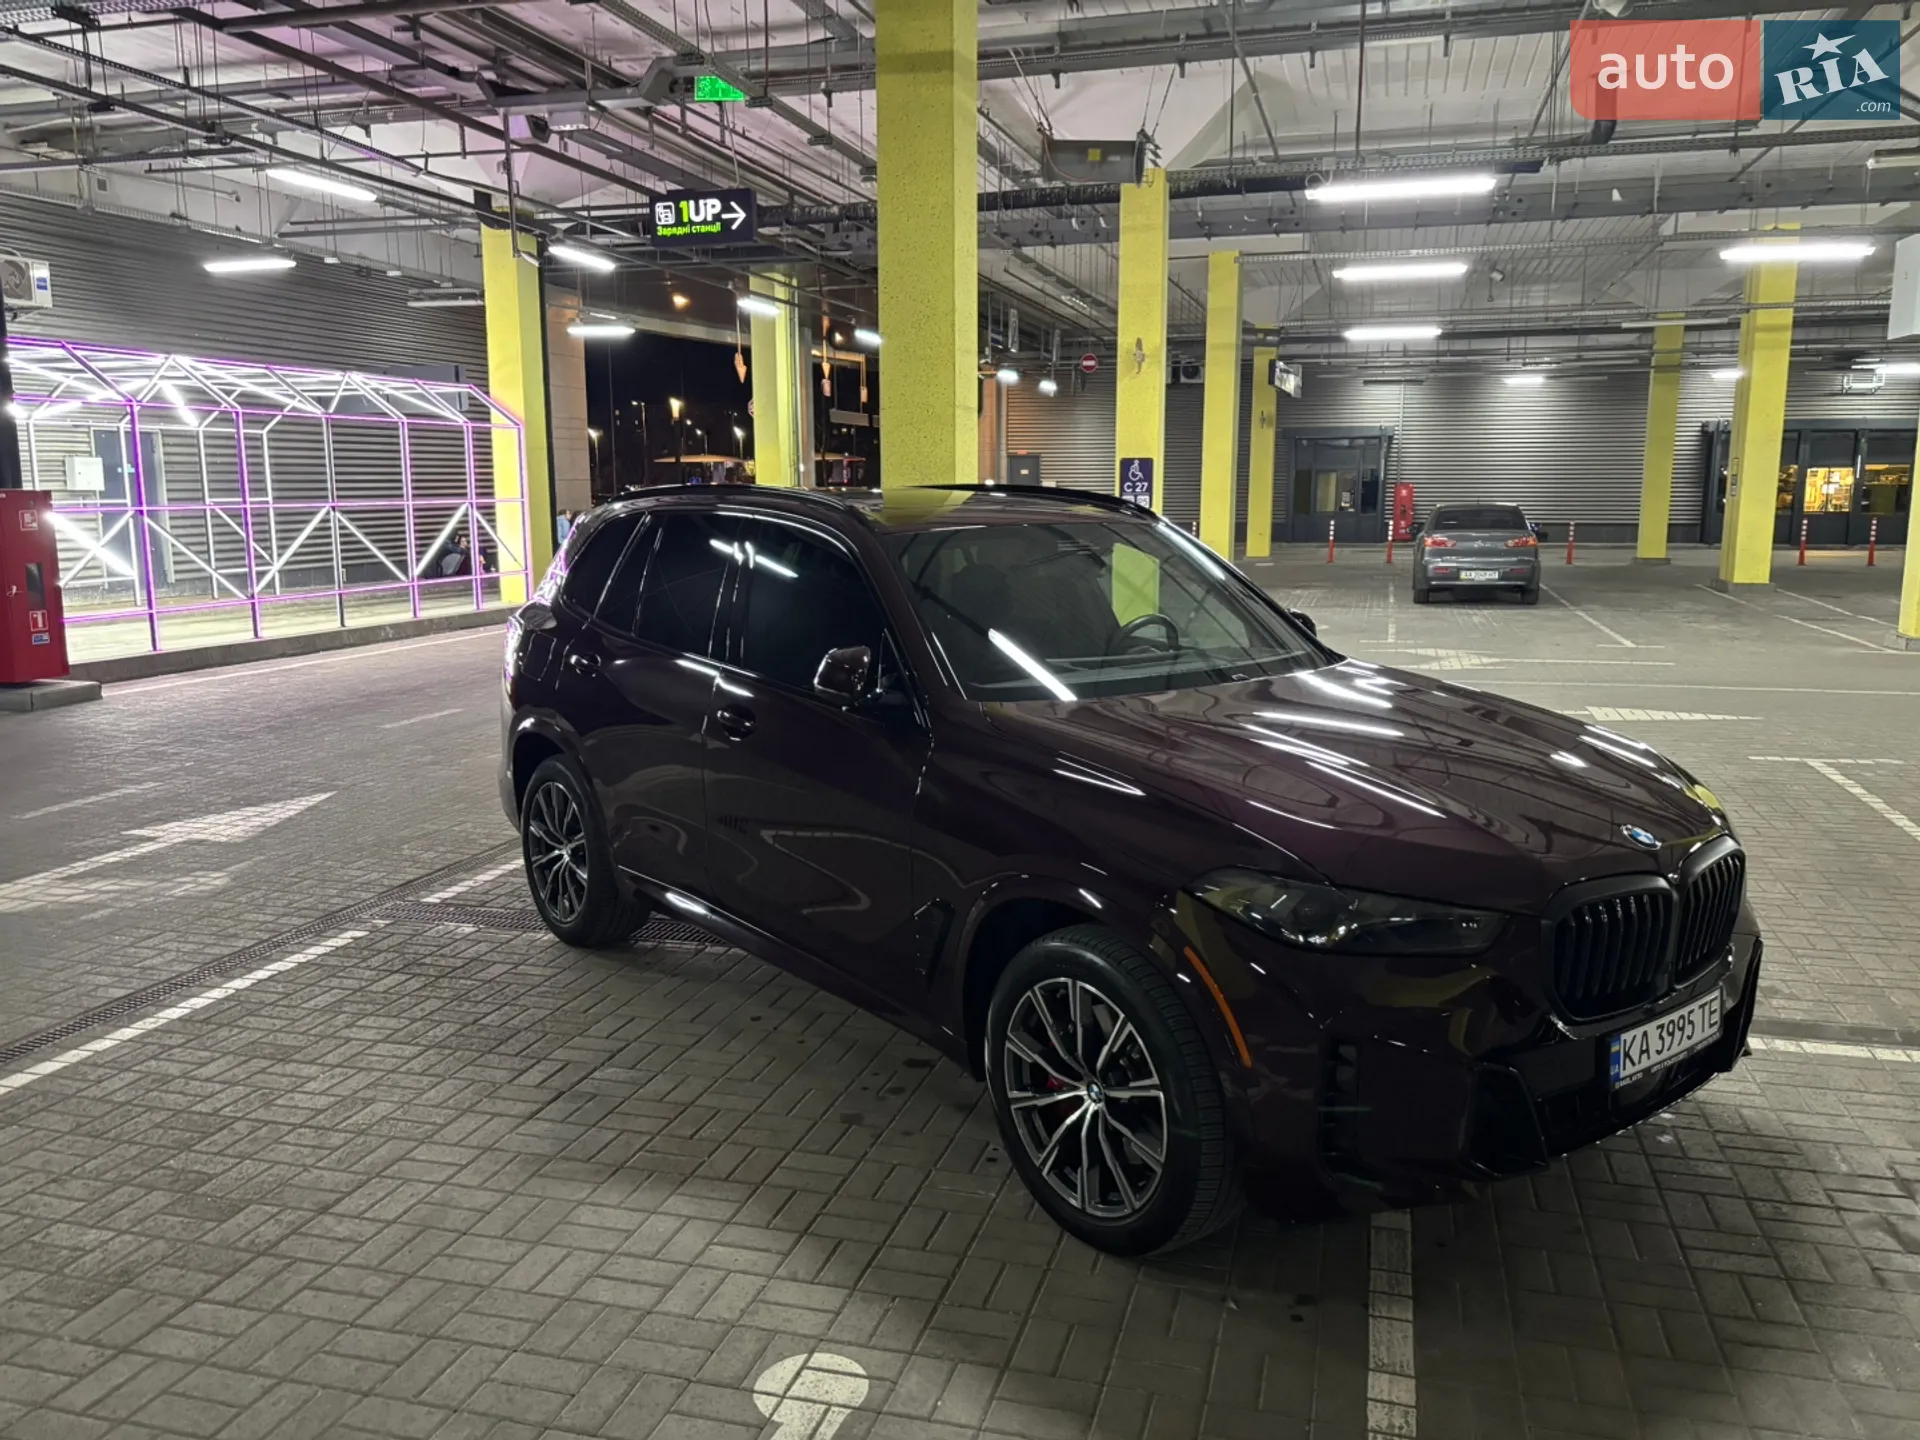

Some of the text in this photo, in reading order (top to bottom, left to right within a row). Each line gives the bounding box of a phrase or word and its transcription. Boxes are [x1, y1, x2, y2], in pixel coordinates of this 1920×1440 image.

[679, 198, 722, 223] 1UP
[657, 222, 721, 237] Зарядні станції
[1123, 482, 1149, 492] C 27
[1622, 1029, 1651, 1072] KA
[1655, 1008, 1695, 1056] 3995
[1698, 995, 1719, 1033] TE
